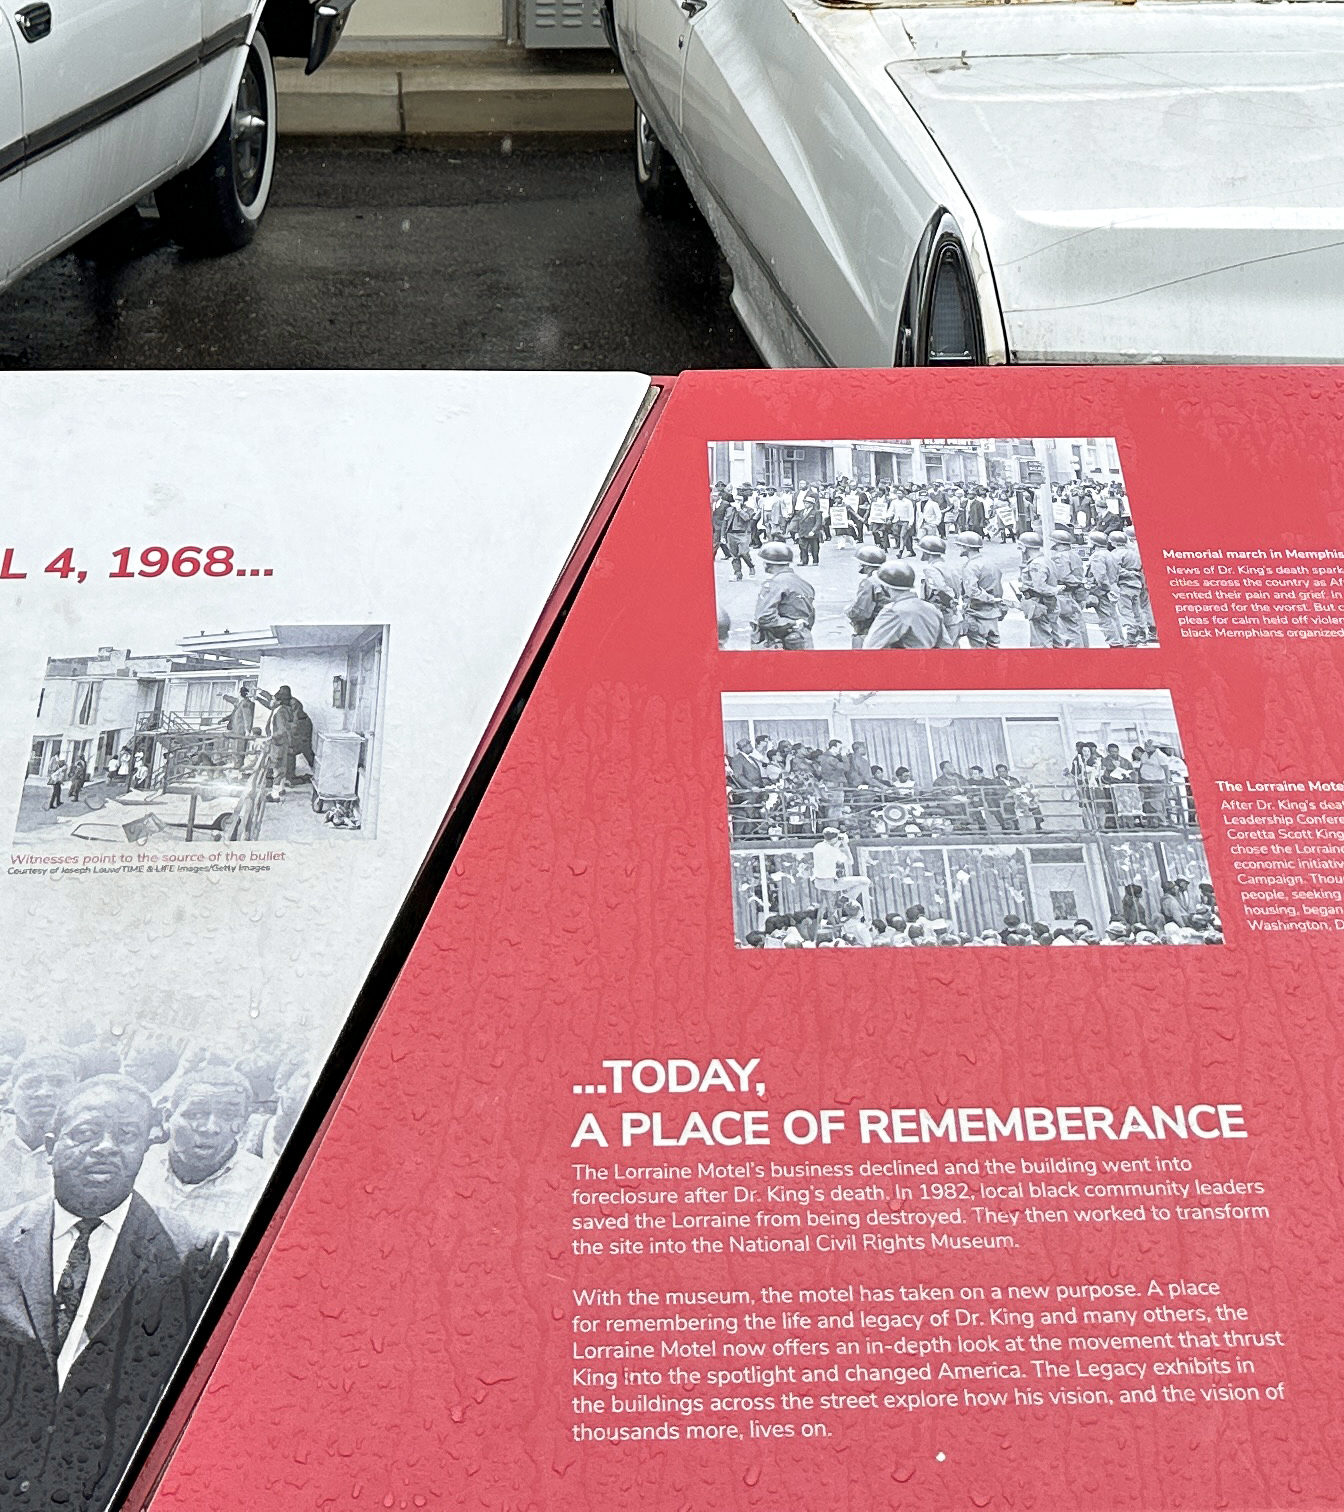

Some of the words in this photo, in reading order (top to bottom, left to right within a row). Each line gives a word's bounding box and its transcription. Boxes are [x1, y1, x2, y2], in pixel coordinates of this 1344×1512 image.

[1162, 549, 1223, 558] Memorial
[1226, 549, 1267, 558] march
[1269, 548, 1282, 559] in
[43, 547, 87, 584] 4,
[108, 545, 273, 578] 1968...
[1166, 565, 1200, 574] News
[1203, 565, 1214, 574] of
[1275, 565, 1309, 574] death
[1215, 780, 1242, 791] The
[1245, 780, 1305, 791] Lorraine
[1220, 799, 1252, 810] After
[1256, 799, 1274, 809] Dr.
[10, 854, 79, 864] Witnesses
[82, 853, 116, 866] point
[119, 853, 133, 862] to
[136, 852, 158, 862] the
[161, 853, 205, 862] source
[208, 851, 221, 865] of
[224, 850, 246, 861] the
[249, 850, 286, 861] bullet
[570, 1113, 608, 1147] A
[622, 1110, 770, 1146] PLACE
[783, 1109, 844, 1144] OF
[858, 1105, 1247, 1143] REMEMBERANCE
[571, 1164, 608, 1180] The
[614, 1162, 691, 1179] Lorraine
[697, 1161, 764, 1178] Motel's
[770, 1160, 853, 1177] business
[859, 1159, 938, 1176] declined
[944, 1158, 979, 1174] and
[983, 1158, 1015, 1174] the
[1020, 1157, 1096, 1176] building
[1101, 1157, 1151, 1172] went
[1154, 1155, 1192, 1171] into
[572, 1212, 628, 1230] saved
[634, 1212, 665, 1228] the
[672, 1211, 750, 1228] Lorraine
[755, 1210, 800, 1226] from
[806, 1210, 859, 1229] being
[866, 1207, 966, 1227] destroyed.
[970, 1206, 1019, 1225] They
[1024, 1206, 1068, 1222] then
[1073, 1204, 1145, 1221] worked
[1150, 1205, 1170, 1220] to
[1175, 1202, 1269, 1219] transform
[571, 1238, 603, 1254] the
[609, 1237, 643, 1254] site
[649, 1237, 686, 1253] into
[690, 1236, 722, 1253] the
[729, 1234, 809, 1252] National
[815, 1234, 856, 1251] Civil
[862, 1233, 925, 1253] Rights
[930, 1232, 1019, 1249] Museum.
